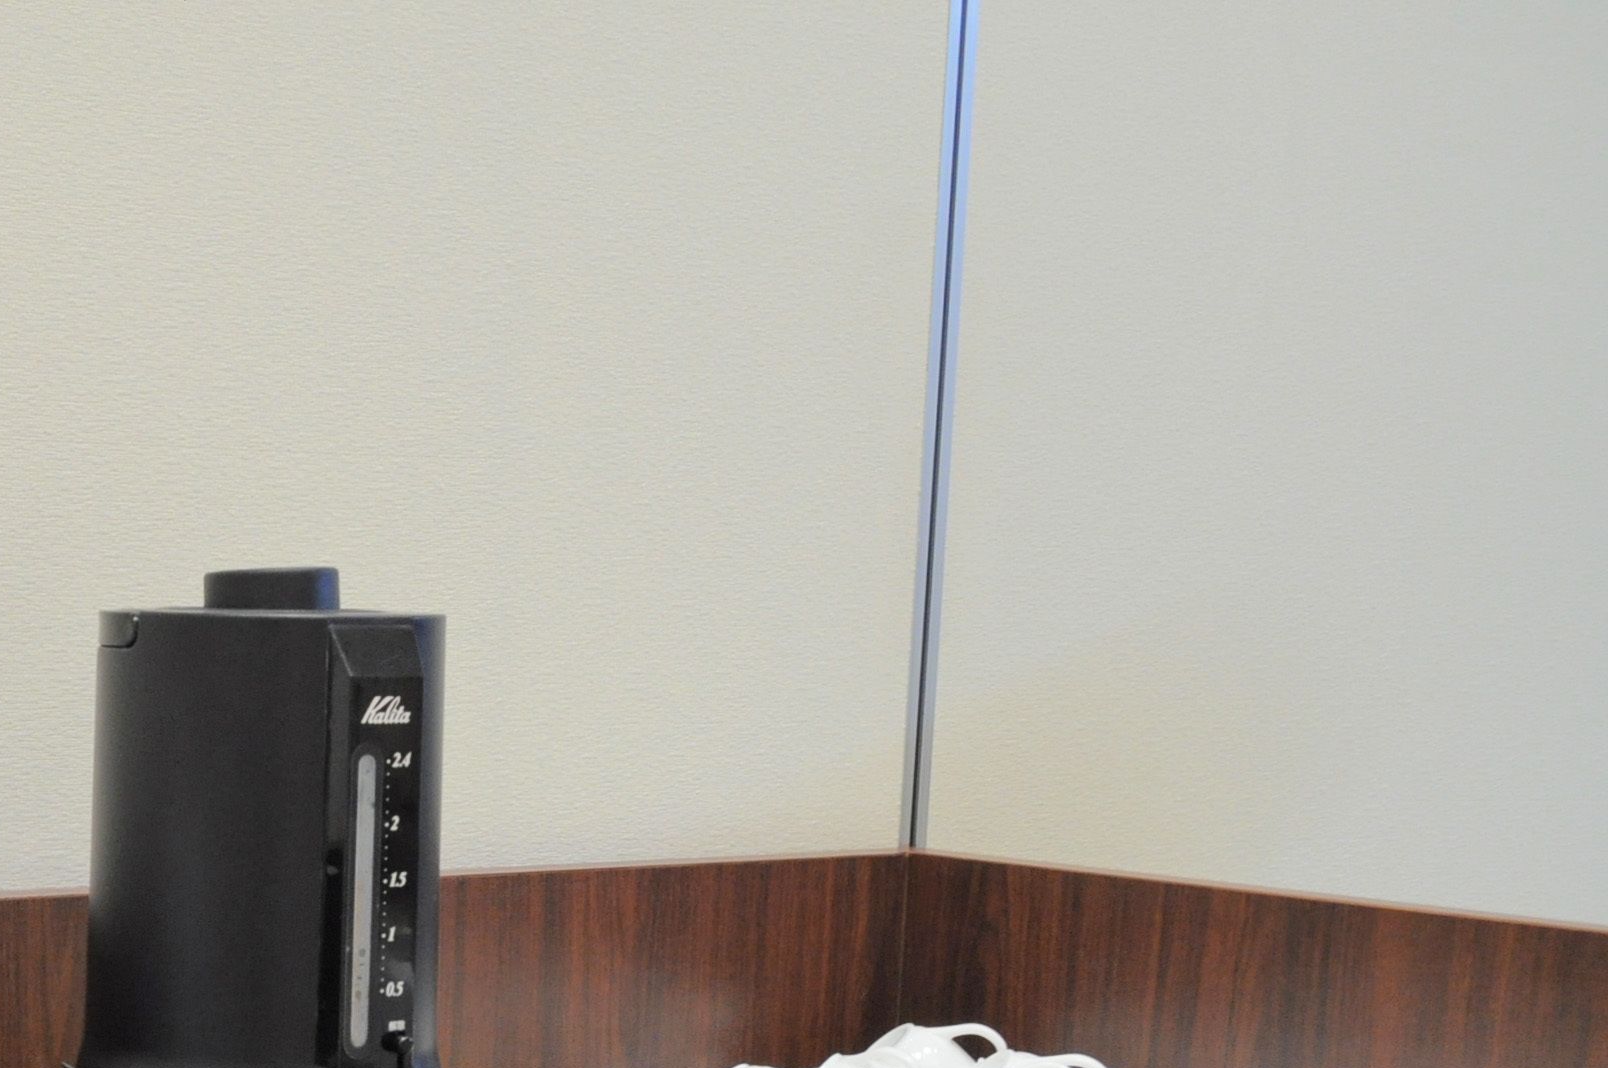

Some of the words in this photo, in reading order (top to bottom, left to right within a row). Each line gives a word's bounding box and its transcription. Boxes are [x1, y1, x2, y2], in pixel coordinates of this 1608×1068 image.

[360, 695, 412, 725] Kalita
[392, 751, 412, 768] 2.4
[390, 815, 400, 831] 2
[387, 926, 397, 942] 1
